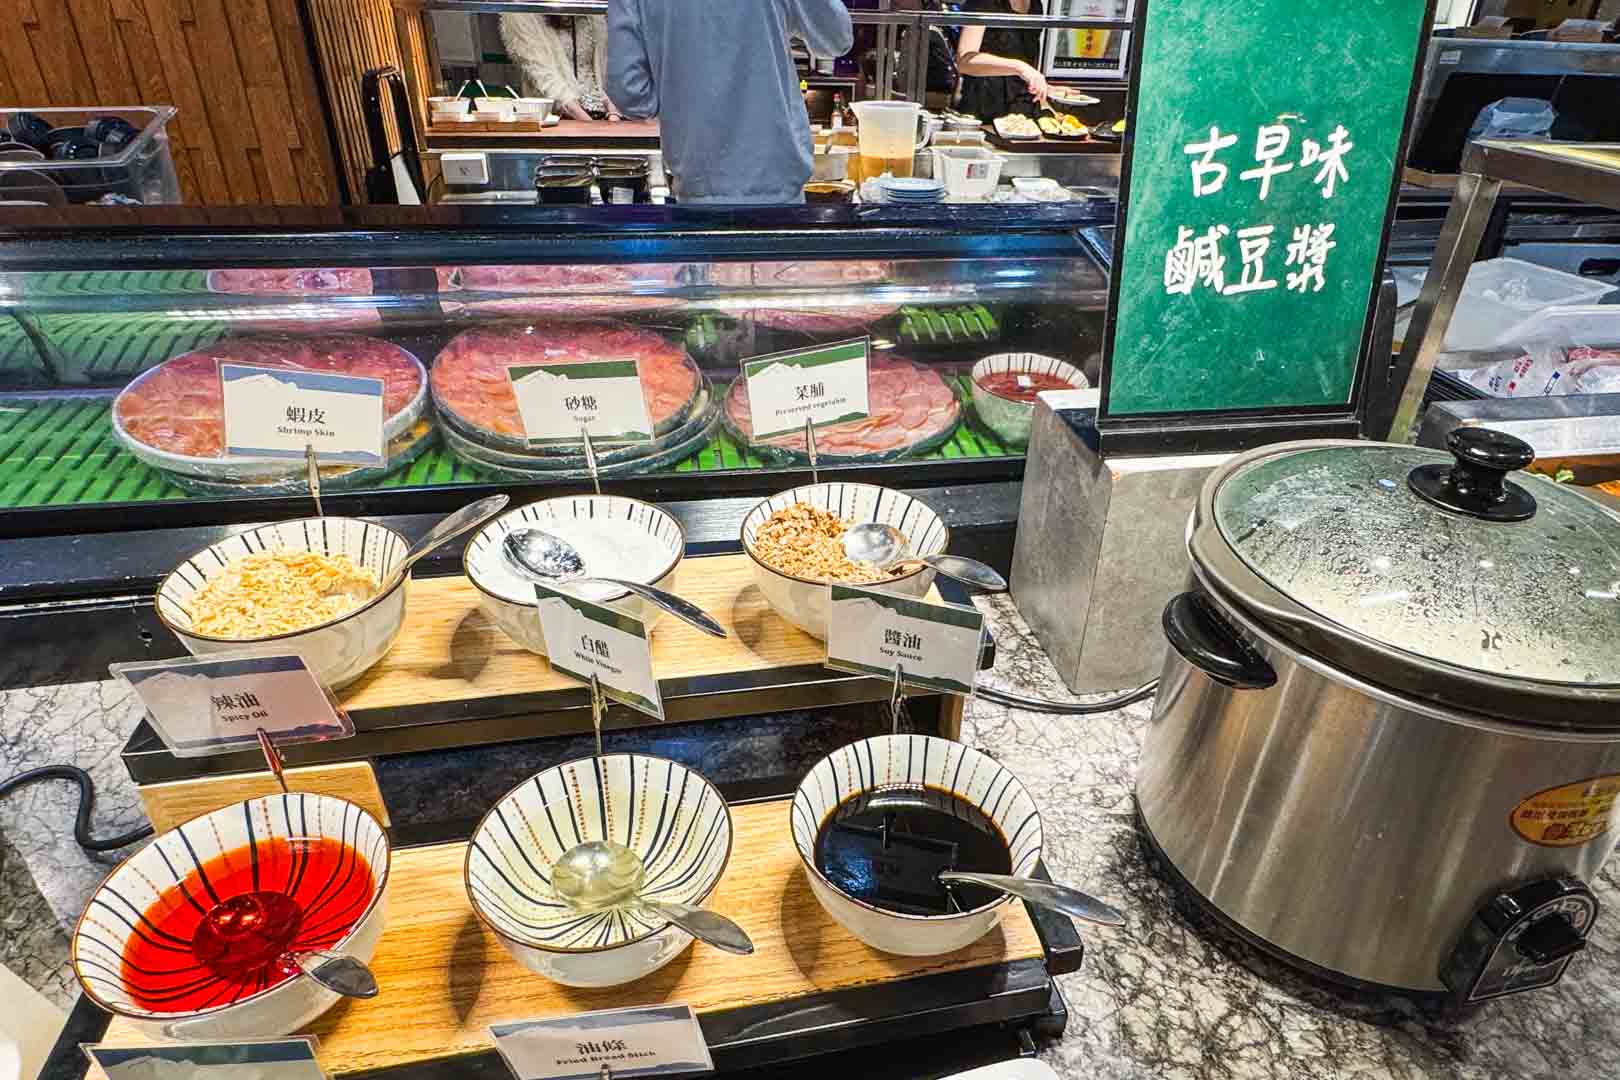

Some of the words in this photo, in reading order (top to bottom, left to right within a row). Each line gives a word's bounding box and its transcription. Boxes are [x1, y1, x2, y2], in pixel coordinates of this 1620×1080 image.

[1184, 124, 1353, 200] 古早味
[1164, 223, 1337, 296] 鹹豆漿
[796, 381, 825, 401] 菜脯
[565, 395, 598, 411] 砂糖
[775, 403, 812, 416] Preserved
[286, 405, 326, 424] 蝦皮
[277, 426, 313, 437] Shrimp
[314, 429, 335, 438] Skin
[581, 634, 610, 658] 白醋
[885, 628, 922, 650] 醬油
[879, 647, 895, 657] Soy
[897, 650, 923, 661] Sauce
[210, 692, 260, 712] 辣油
[221, 714, 250, 722] Spicy
[556, 1057, 588, 1065] Fried
[590, 1053, 625, 1063] Bread
